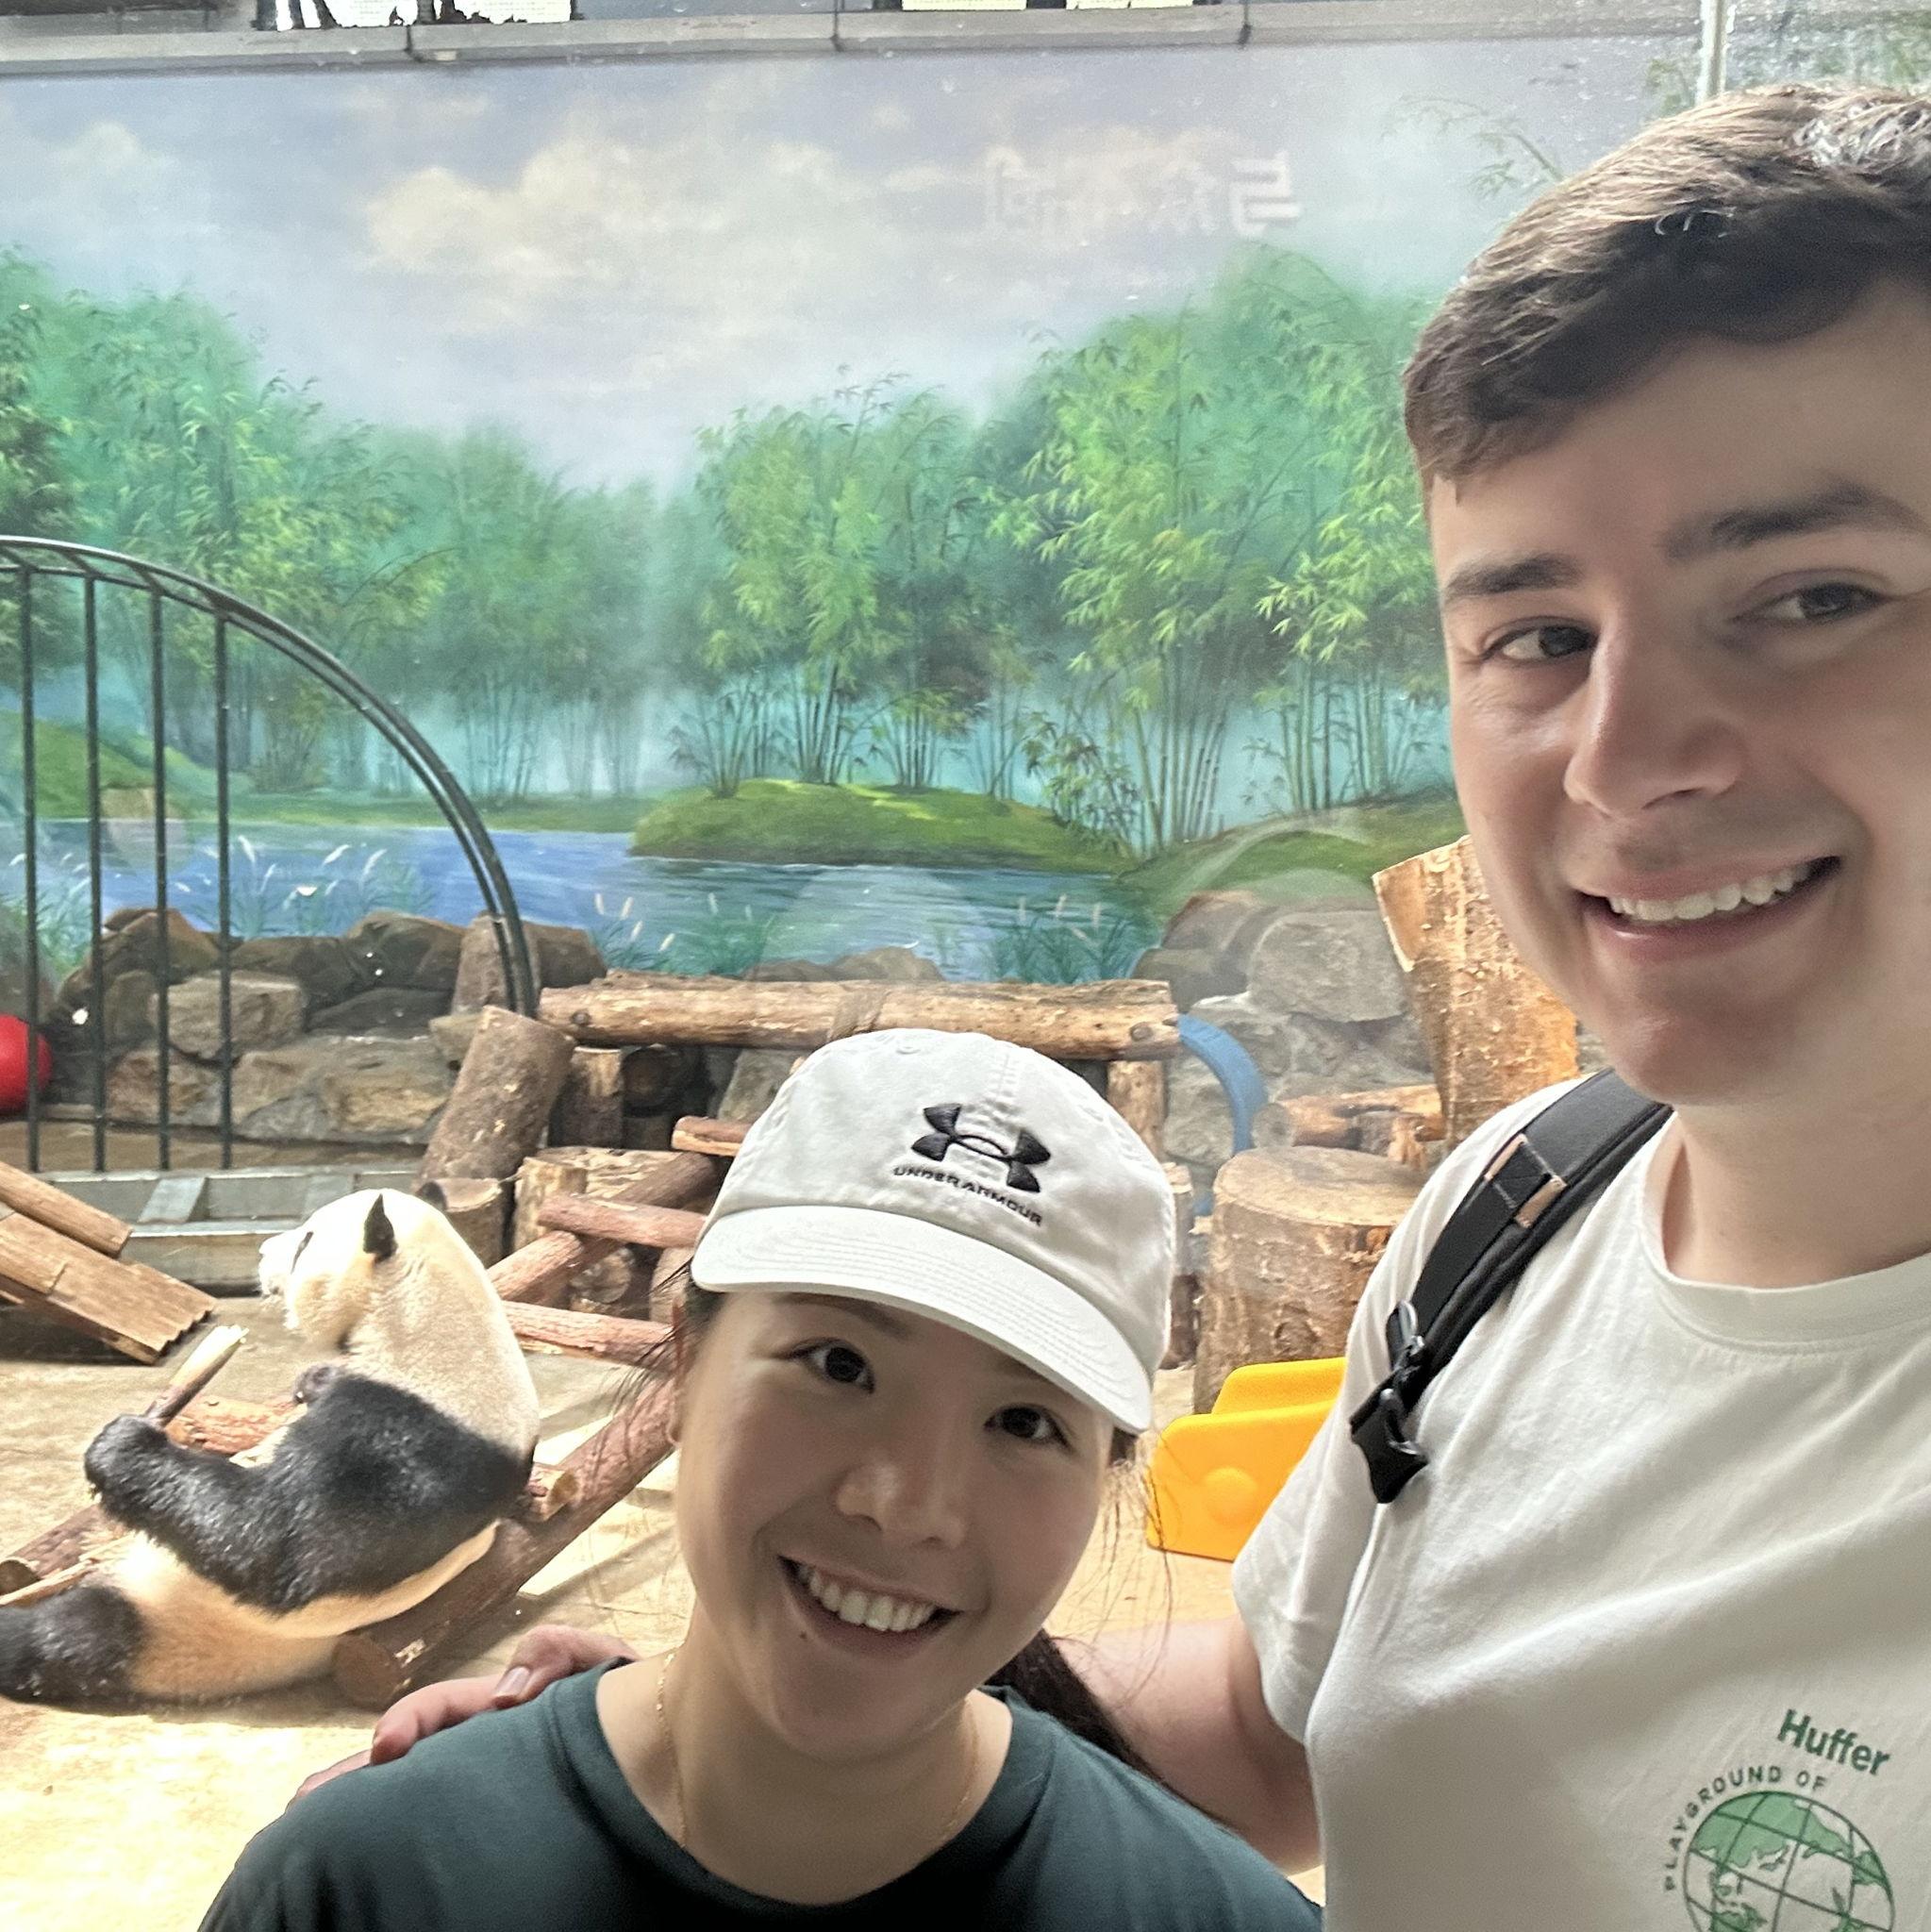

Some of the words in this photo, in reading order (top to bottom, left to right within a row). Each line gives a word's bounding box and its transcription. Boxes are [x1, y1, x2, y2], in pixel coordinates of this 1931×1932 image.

[1777, 1708, 1890, 1775] Huffer
[1664, 1765, 1782, 1891] PLAYGROUND
[1795, 1770, 1827, 1791] OF
